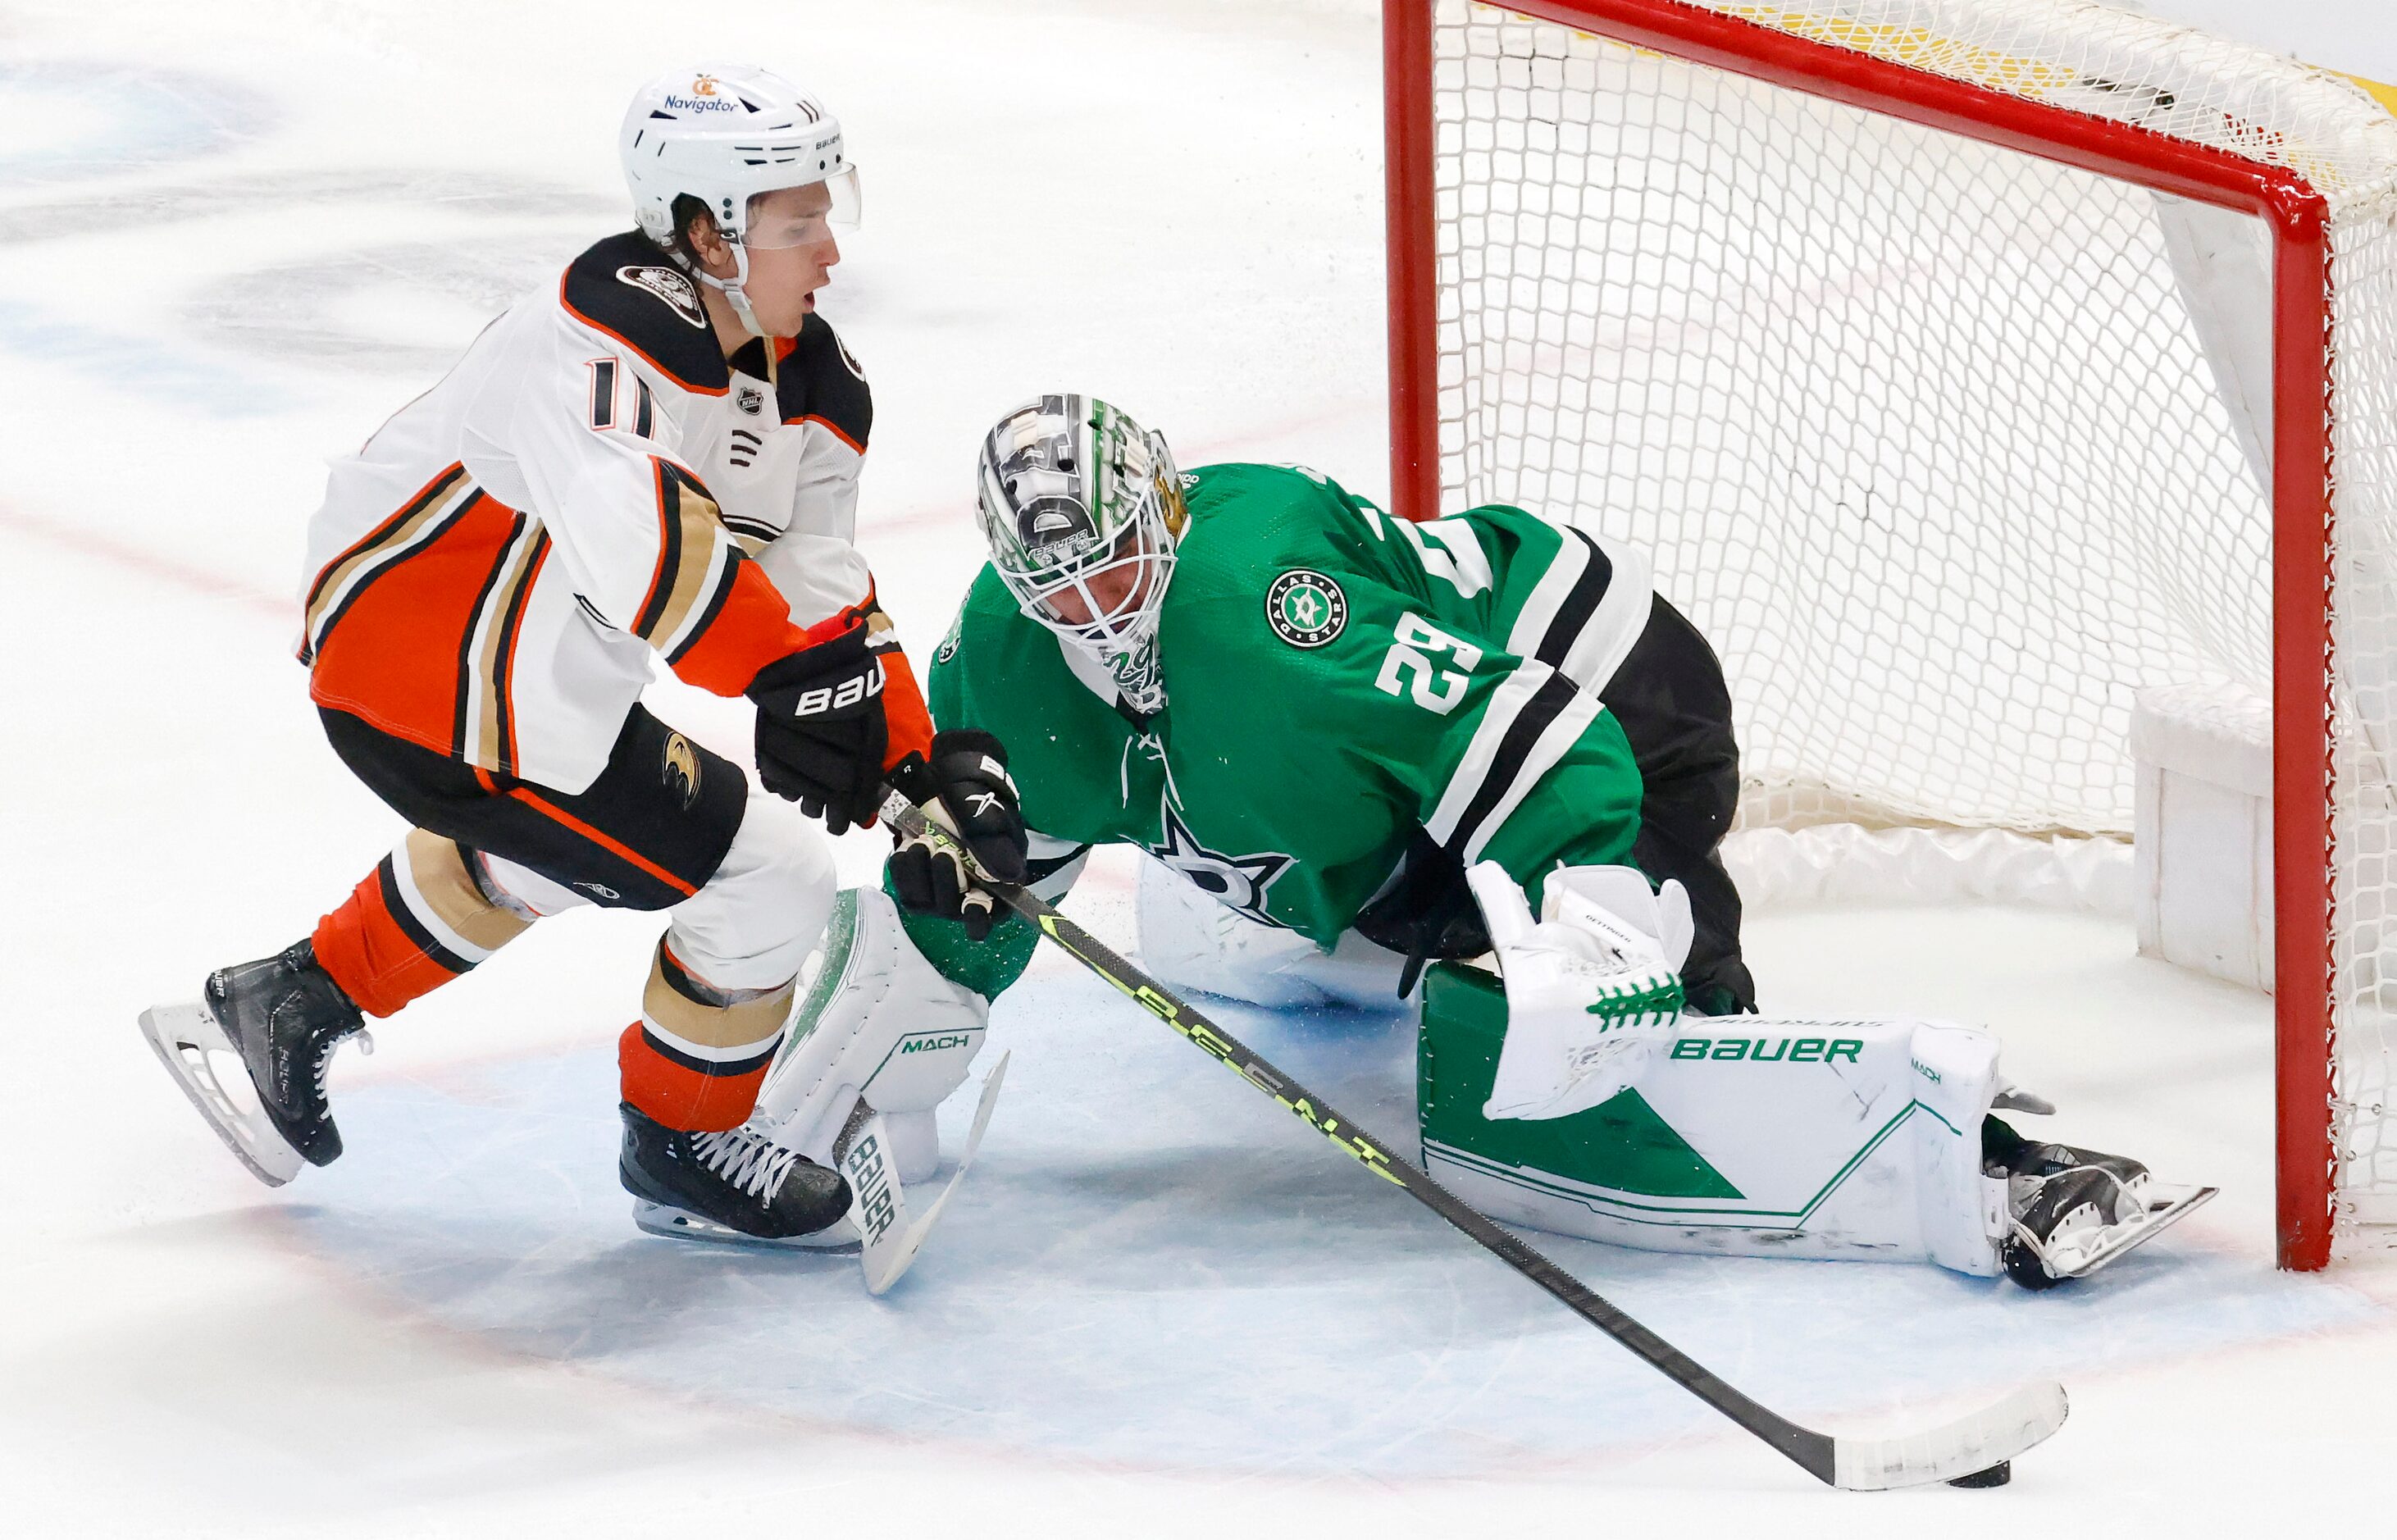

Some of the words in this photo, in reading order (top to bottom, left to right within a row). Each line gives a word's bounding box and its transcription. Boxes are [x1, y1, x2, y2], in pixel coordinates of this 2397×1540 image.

[664, 94, 738, 113] Navigator
[815, 133, 841, 150] BAUER
[583, 357, 656, 441] 11
[741, 397, 759, 407] NHL
[1034, 529, 1088, 559] BAUER
[1273, 575, 1312, 635] DALLAS
[1309, 589, 1342, 642] STARS
[1102, 631, 1155, 690] 29
[1374, 611, 1483, 716] 29
[901, 1035, 969, 1054] MACH
[1670, 1039, 1864, 1064] BAUER
[1911, 1058, 1941, 1084] MACH
[848, 1133, 895, 1247] BAUER
